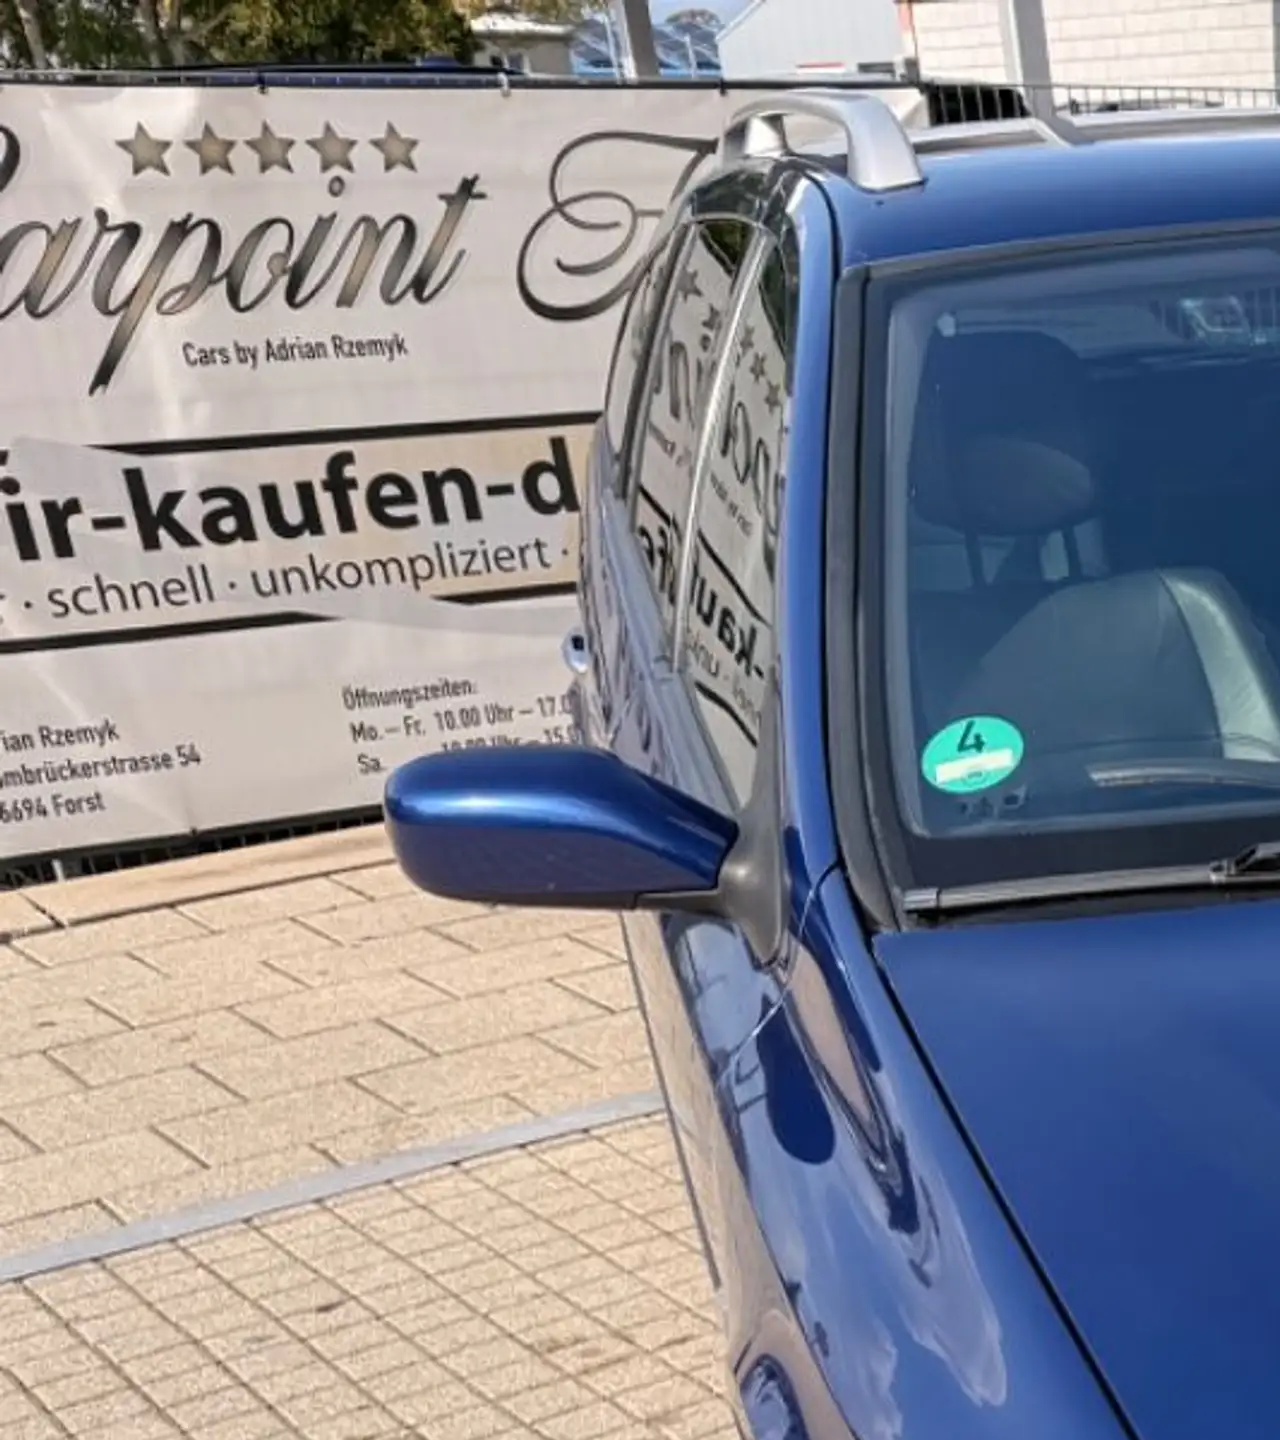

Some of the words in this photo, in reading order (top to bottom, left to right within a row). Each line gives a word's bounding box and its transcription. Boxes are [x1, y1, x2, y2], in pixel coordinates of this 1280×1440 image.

[0, 124, 487, 396] arpoint
[182, 342, 231, 367] Cars
[233, 339, 259, 371] by
[265, 336, 329, 363] Adrian
[331, 332, 408, 362] Rzemyk
[0, 437, 581, 561] ir-kaufen-d
[48, 563, 215, 618] schnell
[251, 537, 551, 598] unkompliziert
[341, 677, 478, 710] Öffnungszeiten:
[434, 706, 482, 732] 10.00
[484, 702, 514, 725] Uhr
[536, 693, 574, 717] 17.0
[0, 729, 35, 752] ian
[38, 718, 119, 748] Rzemyk
[957, 720, 985, 753] 4
[0, 750, 173, 788] mbrückerstrasse
[175, 742, 201, 768] 54
[0, 796, 48, 823] 6694
[52, 791, 106, 817] Forst
